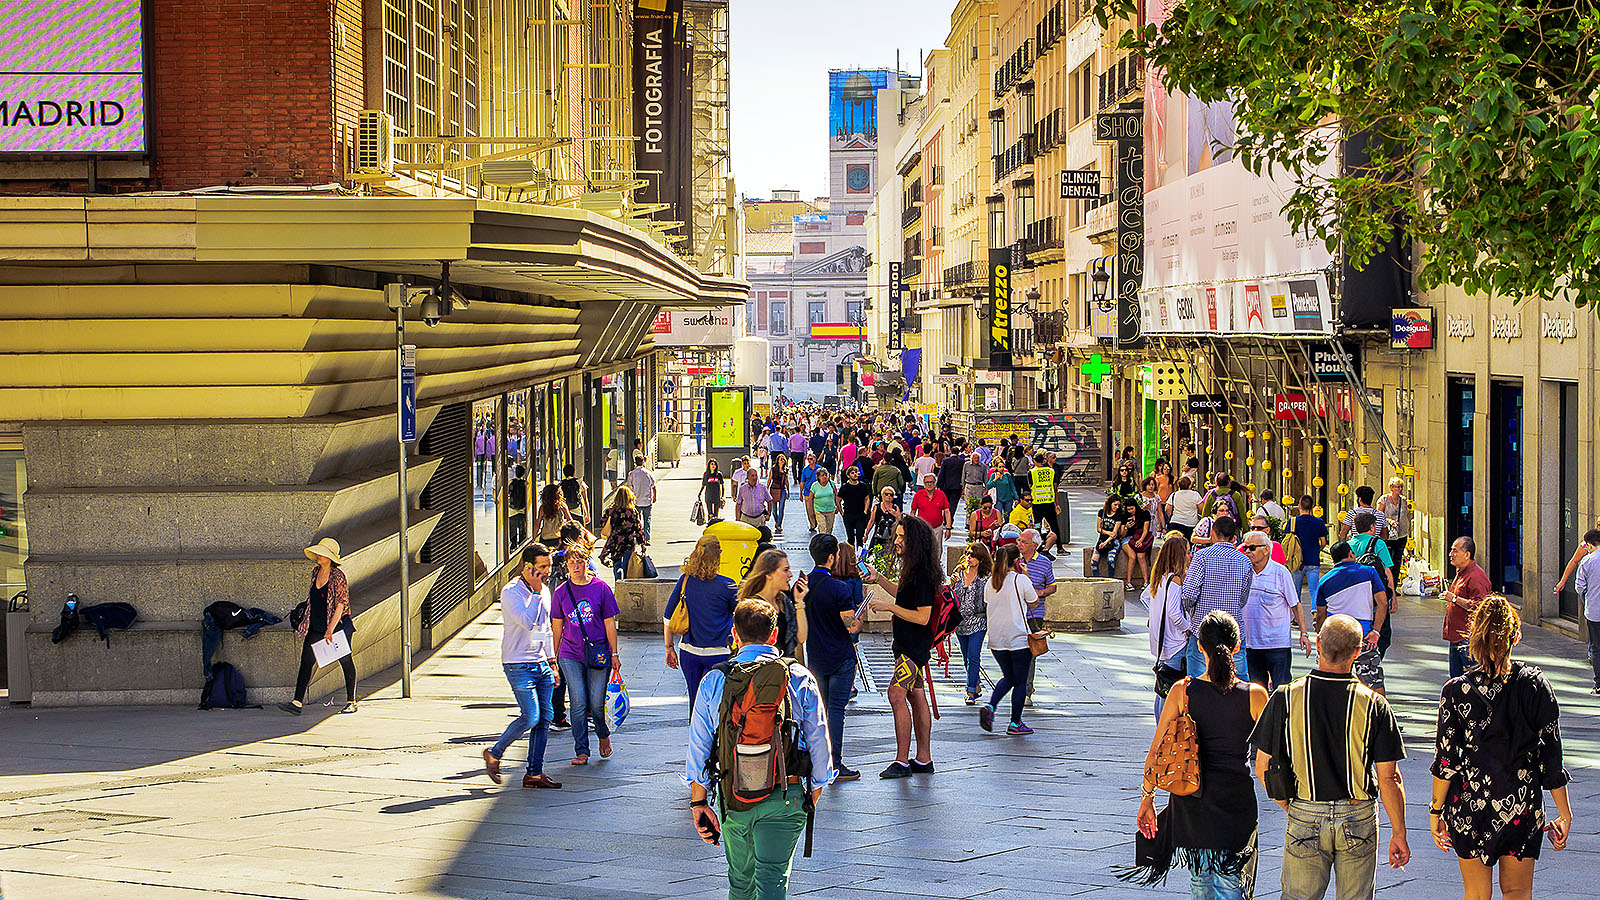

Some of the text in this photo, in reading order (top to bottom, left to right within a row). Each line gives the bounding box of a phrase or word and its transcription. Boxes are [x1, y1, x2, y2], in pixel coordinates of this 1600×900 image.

[642, 29, 663, 153] FOTOGRAFÍA
[1099, 115, 1143, 138] SHO
[1061, 172, 1100, 184] CLINICA
[1062, 185, 1099, 197] DENTAL
[891, 263, 899, 349] SPORT 2000
[992, 264, 1008, 350] Atrezzo
[1176, 297, 1195, 320] GEOX
[1395, 324, 1430, 333] Desigual.
